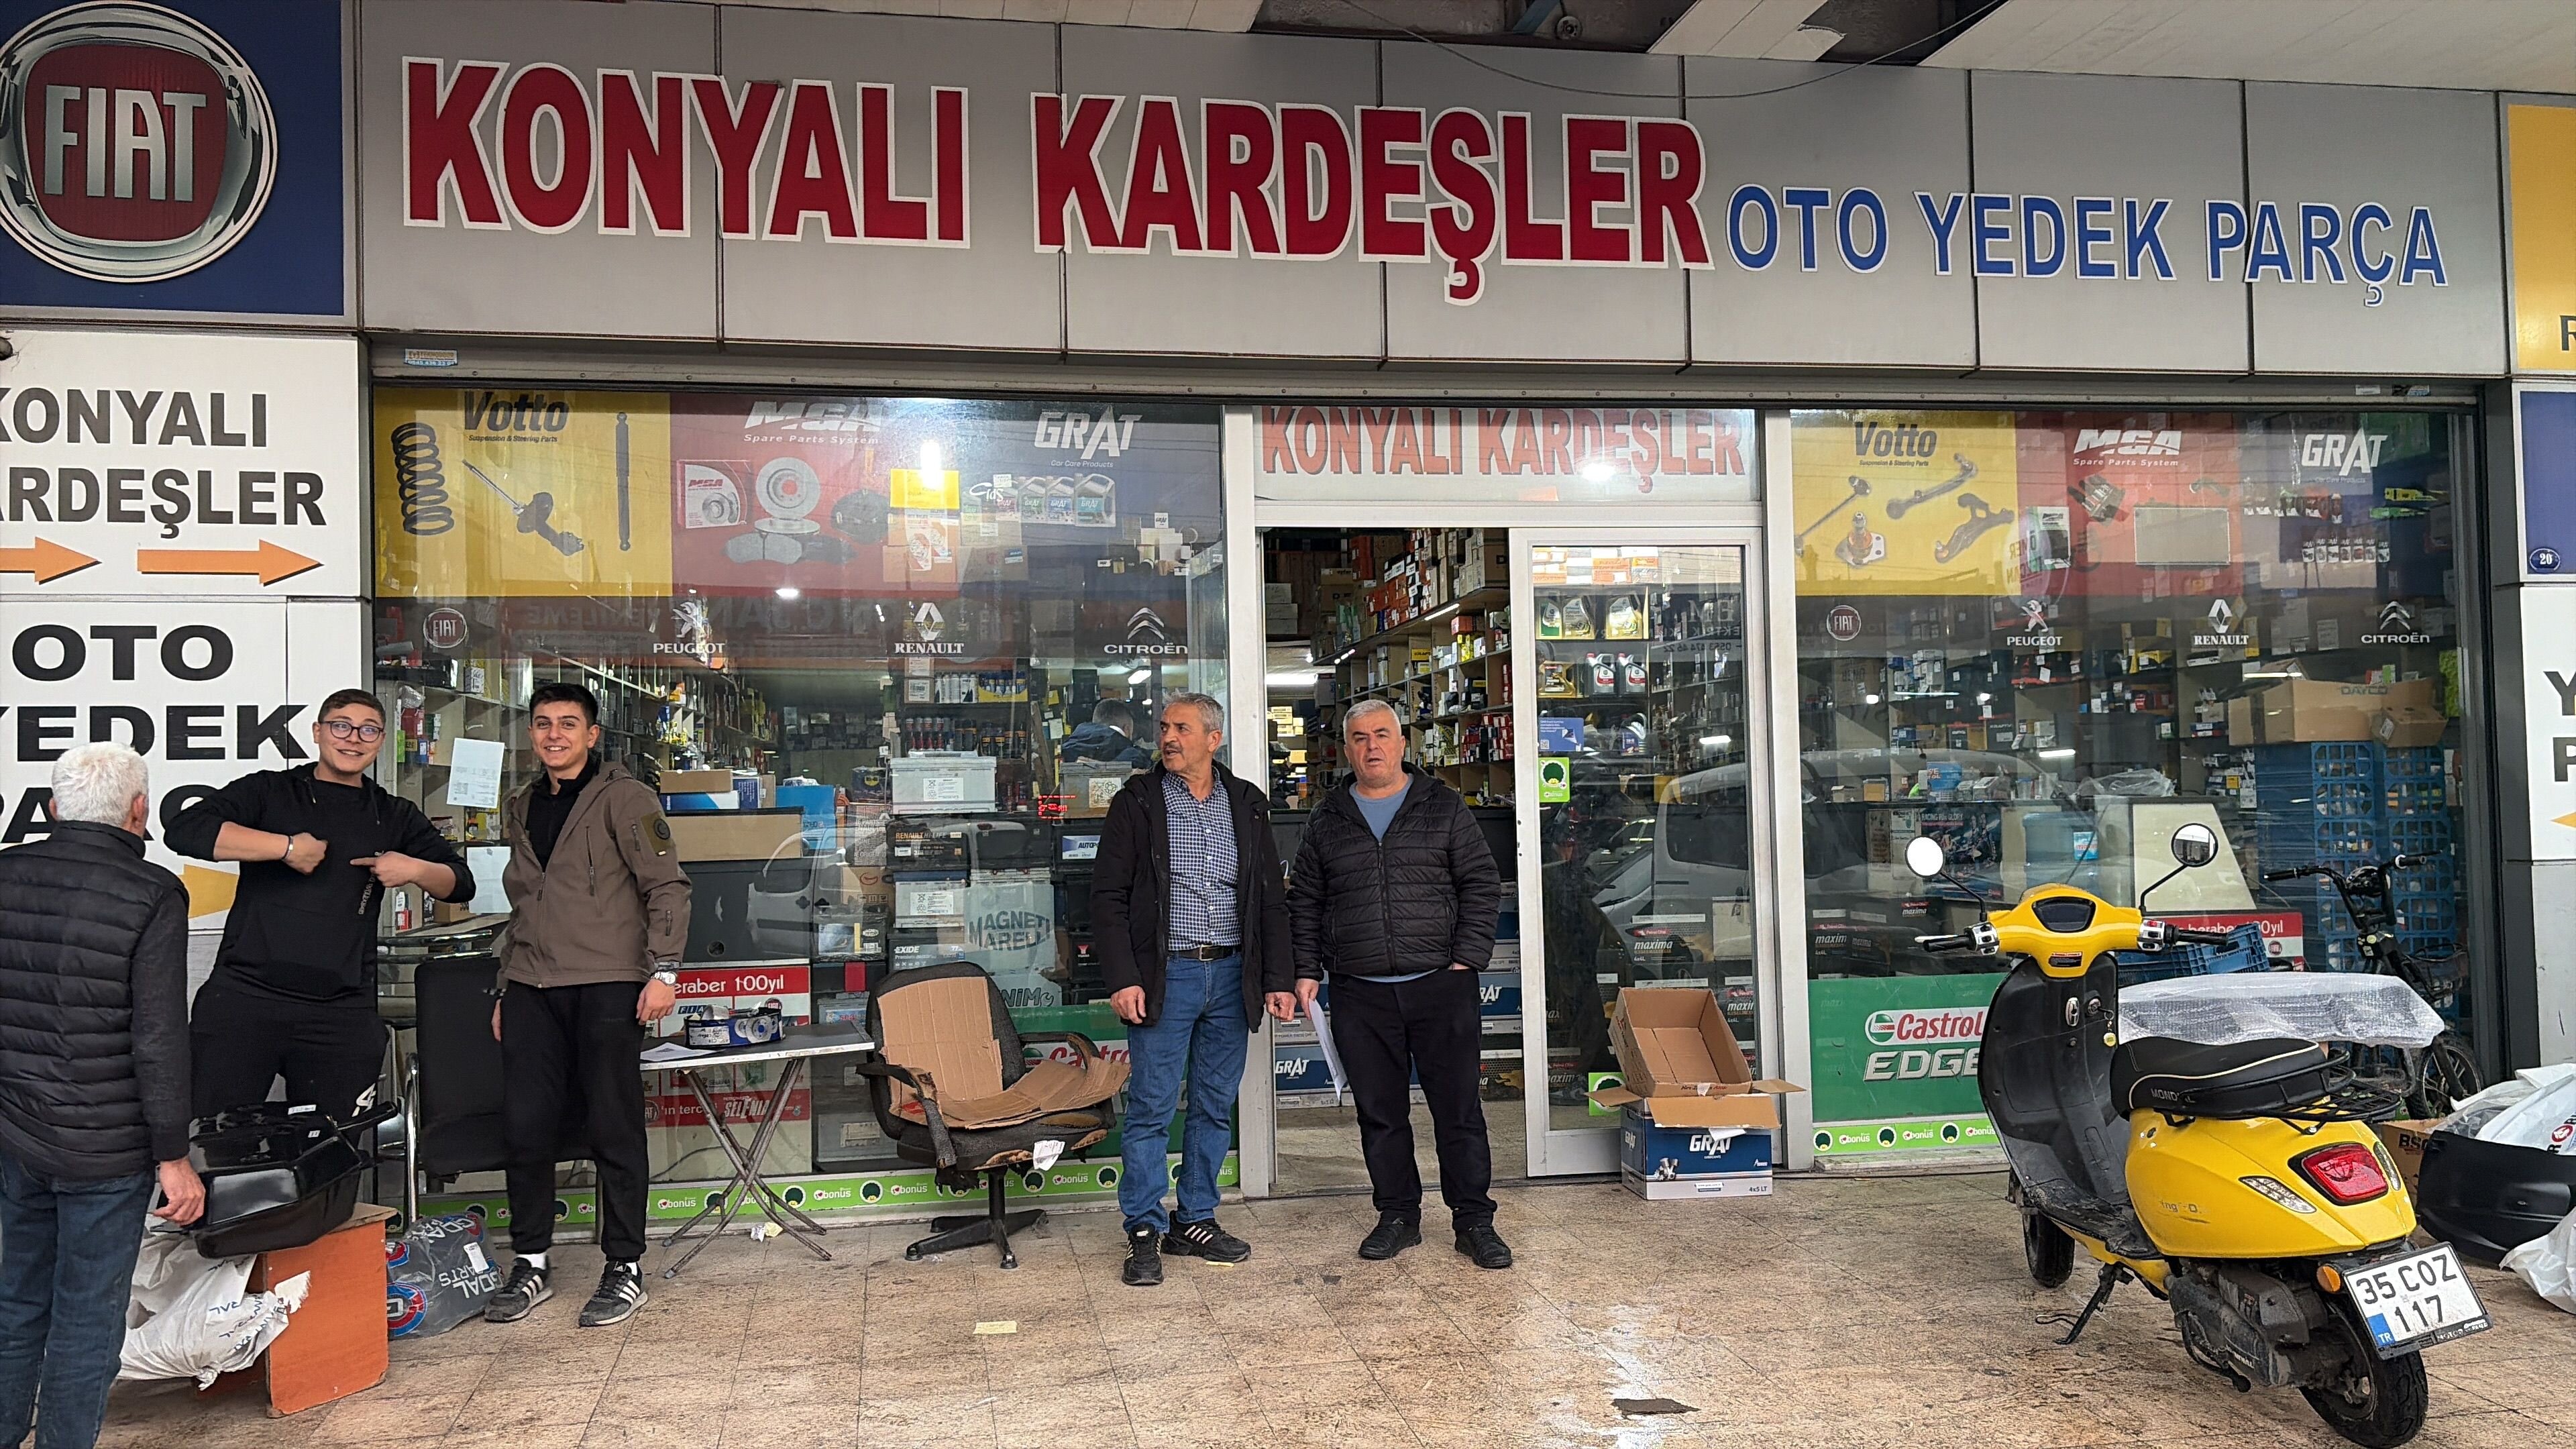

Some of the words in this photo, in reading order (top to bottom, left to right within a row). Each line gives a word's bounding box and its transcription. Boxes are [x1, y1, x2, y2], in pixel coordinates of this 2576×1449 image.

[44, 85, 207, 201] FIAT
[402, 56, 970, 249] KONYALI
[1030, 92, 1715, 306] KARDEŞLER
[1726, 182, 1889, 274] OTO
[1913, 191, 2177, 281] YEDEK
[2204, 199, 2448, 307] PARÇA
[0, 388, 266, 447] ONYALI
[464, 391, 570, 433] Votto
[745, 400, 883, 432] MGA
[1034, 405, 1142, 460] GRAT
[469, 434, 506, 443] Suspension
[513, 435, 541, 445] Steering
[541, 435, 558, 443] Parts
[743, 434, 785, 445] Spare
[787, 435, 825, 445] Parts
[829, 435, 879, 447] System
[1854, 421, 1937, 458] Votto
[2074, 429, 2182, 456] MGA
[1263, 405, 1463, 475] KONYALI
[1479, 407, 1746, 494] KARDEŞLER
[2302, 428, 2387, 476] GRAT
[1051, 460, 1064, 468] Car
[1065, 460, 1081, 468] Care
[1082, 460, 1114, 469] Products
[1894, 460, 1916, 468] Steering
[2073, 458, 2104, 468] Spare
[2108, 458, 2137, 467] Parts
[2141, 459, 2179, 468] System
[688, 479, 723, 488] MGA
[0, 467, 327, 539] RDEŞLER
[1051, 499, 1067, 508] GRAT
[1081, 499, 1099, 508] GRAT
[2539, 553, 2553, 565] 20
[433, 621, 458, 637] FIAT
[1834, 616, 1853, 631] FIAT
[2006, 636, 2063, 647] PEUGEOT
[2194, 635, 2249, 645] RENAULT
[2361, 631, 2430, 643] CITROËN
[12, 625, 233, 681] OTO
[653, 643, 725, 654] PEUGEOT
[895, 643, 965, 654] RENAULT
[1104, 641, 1188, 655] CITROËN
[2341, 686, 2388, 695] DAYCO
[0, 704, 309, 762] EDEK
[1921, 813, 1938, 821] RACING
[1948, 813, 1964, 821] GLORY
[969, 910, 1051, 941] MAGNETI
[1633, 940, 1674, 951] maxima
[675, 978, 727, 994] eraber
[1896, 1010, 1982, 1042] Castrol
[1275, 1057, 1309, 1077] GRAT
[2151, 1088, 2196, 1104] MONDL
[724, 1098, 770, 1118] SELENIA
[1910, 1130, 1933, 1139] bonus
[1973, 1127, 1996, 1136] bonus
[1847, 1134, 1870, 1143] bonus
[1062, 1173, 1089, 1183] bonus
[823, 1187, 851, 1199] bonus
[900, 1184, 928, 1195] bonus
[668, 1197, 696, 1209] bonus
[453, 1271, 504, 1299] GOAL
[2356, 1272, 2396, 1304] 35
[2398, 1254, 2457, 1291] COZ
[2394, 1295, 2443, 1332] 117
[2377, 1333, 2392, 1344] TR
